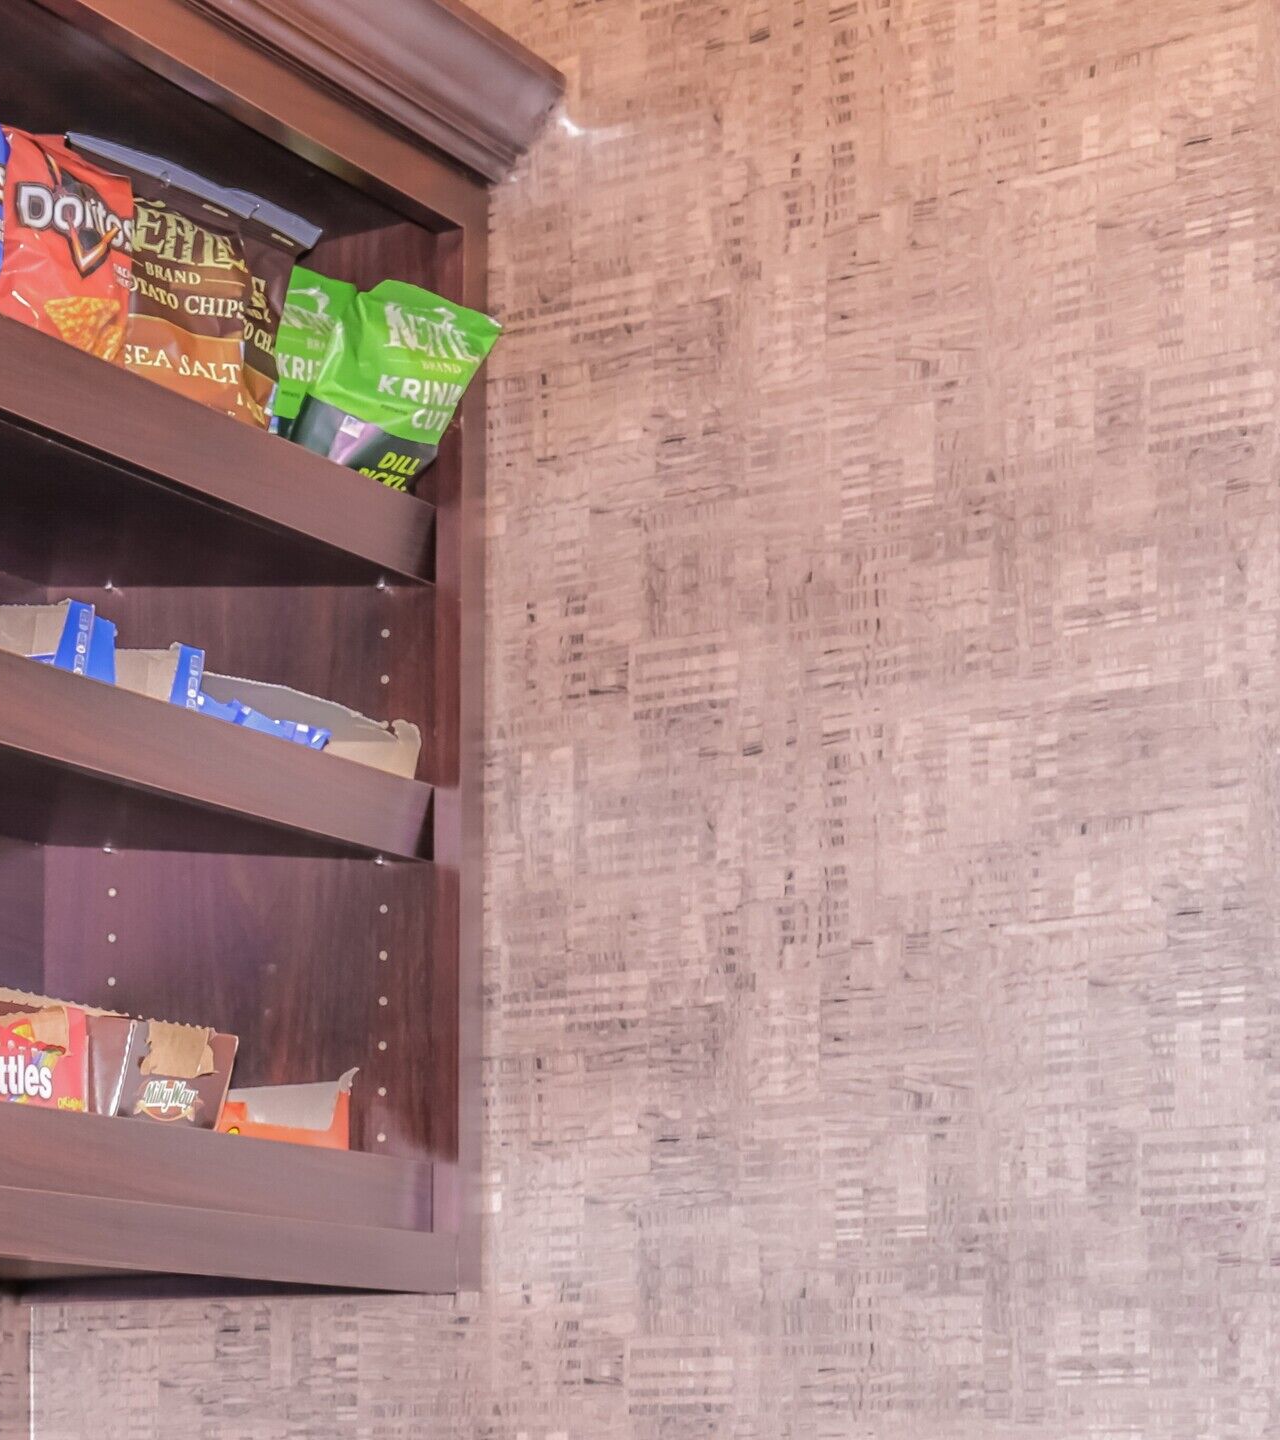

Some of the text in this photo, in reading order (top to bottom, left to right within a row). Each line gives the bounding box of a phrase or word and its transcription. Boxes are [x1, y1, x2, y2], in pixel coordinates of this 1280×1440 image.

[17, 182, 134, 250] Doritos
[144, 261, 201, 286] BRAND
[178, 355, 240, 385] SALT
[377, 451, 421, 476] DILL
